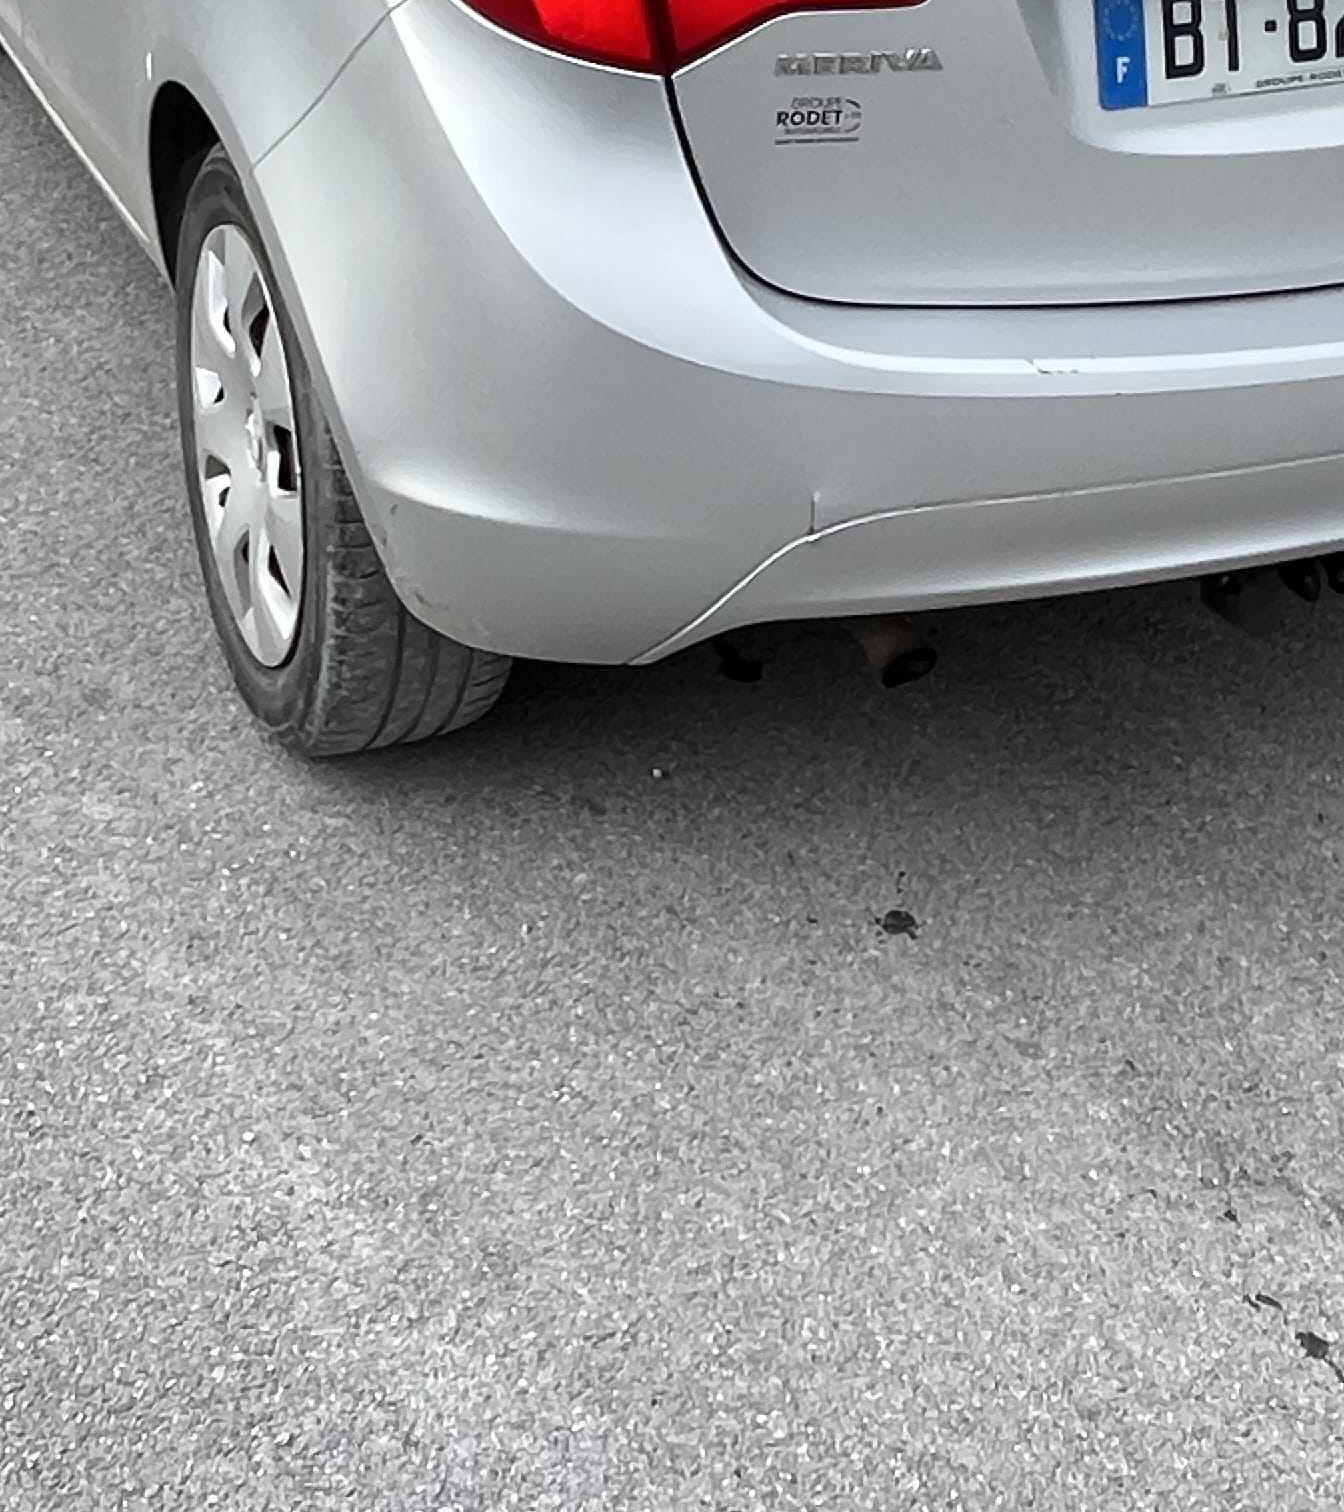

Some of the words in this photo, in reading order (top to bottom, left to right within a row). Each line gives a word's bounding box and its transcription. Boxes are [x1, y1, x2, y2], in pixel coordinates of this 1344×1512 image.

[774, 48, 943, 77] MERIVA
[1116, 56, 1130, 83] F
[776, 110, 843, 126] RODET
